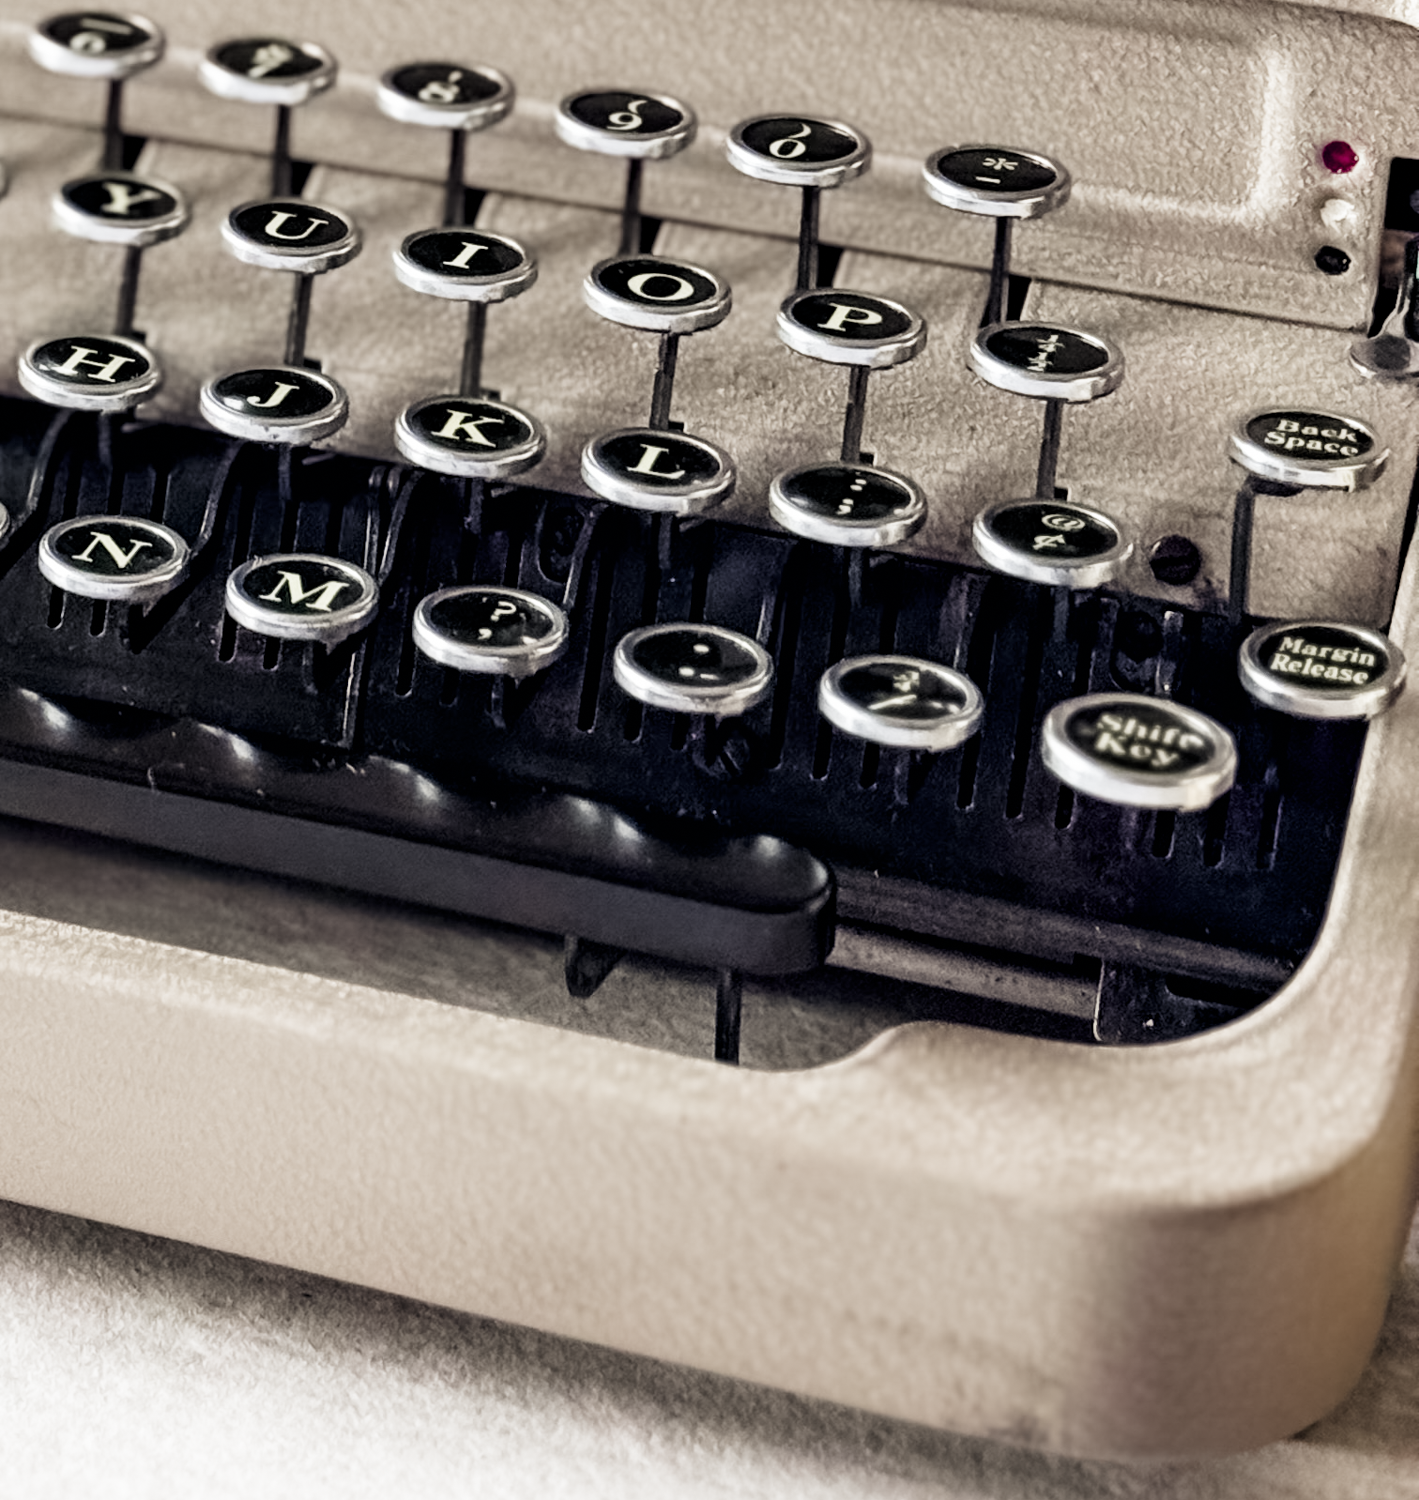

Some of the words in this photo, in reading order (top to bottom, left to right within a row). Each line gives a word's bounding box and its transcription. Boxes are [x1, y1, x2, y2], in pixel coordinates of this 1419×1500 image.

[606, 111, 642, 130] 9
[100, 181, 162, 215] Y
[263, 210, 329, 241] U
[442, 241, 489, 270] I
[626, 272, 695, 302] O
[816, 302, 883, 332] P
[55, 345, 136, 383] H
[245, 381, 300, 409] J
[430, 408, 505, 448] K
[1264, 431, 1359, 457] Space
[1275, 418, 1358, 444] Back
[626, 443, 686, 480] L
[71, 531, 153, 569] N
[258, 570, 350, 612] M
[1280, 636, 1376, 668] Margin
[1270, 654, 1370, 686] Release
[1096, 712, 1206, 750] Shift
[1093, 731, 1180, 768] Key
